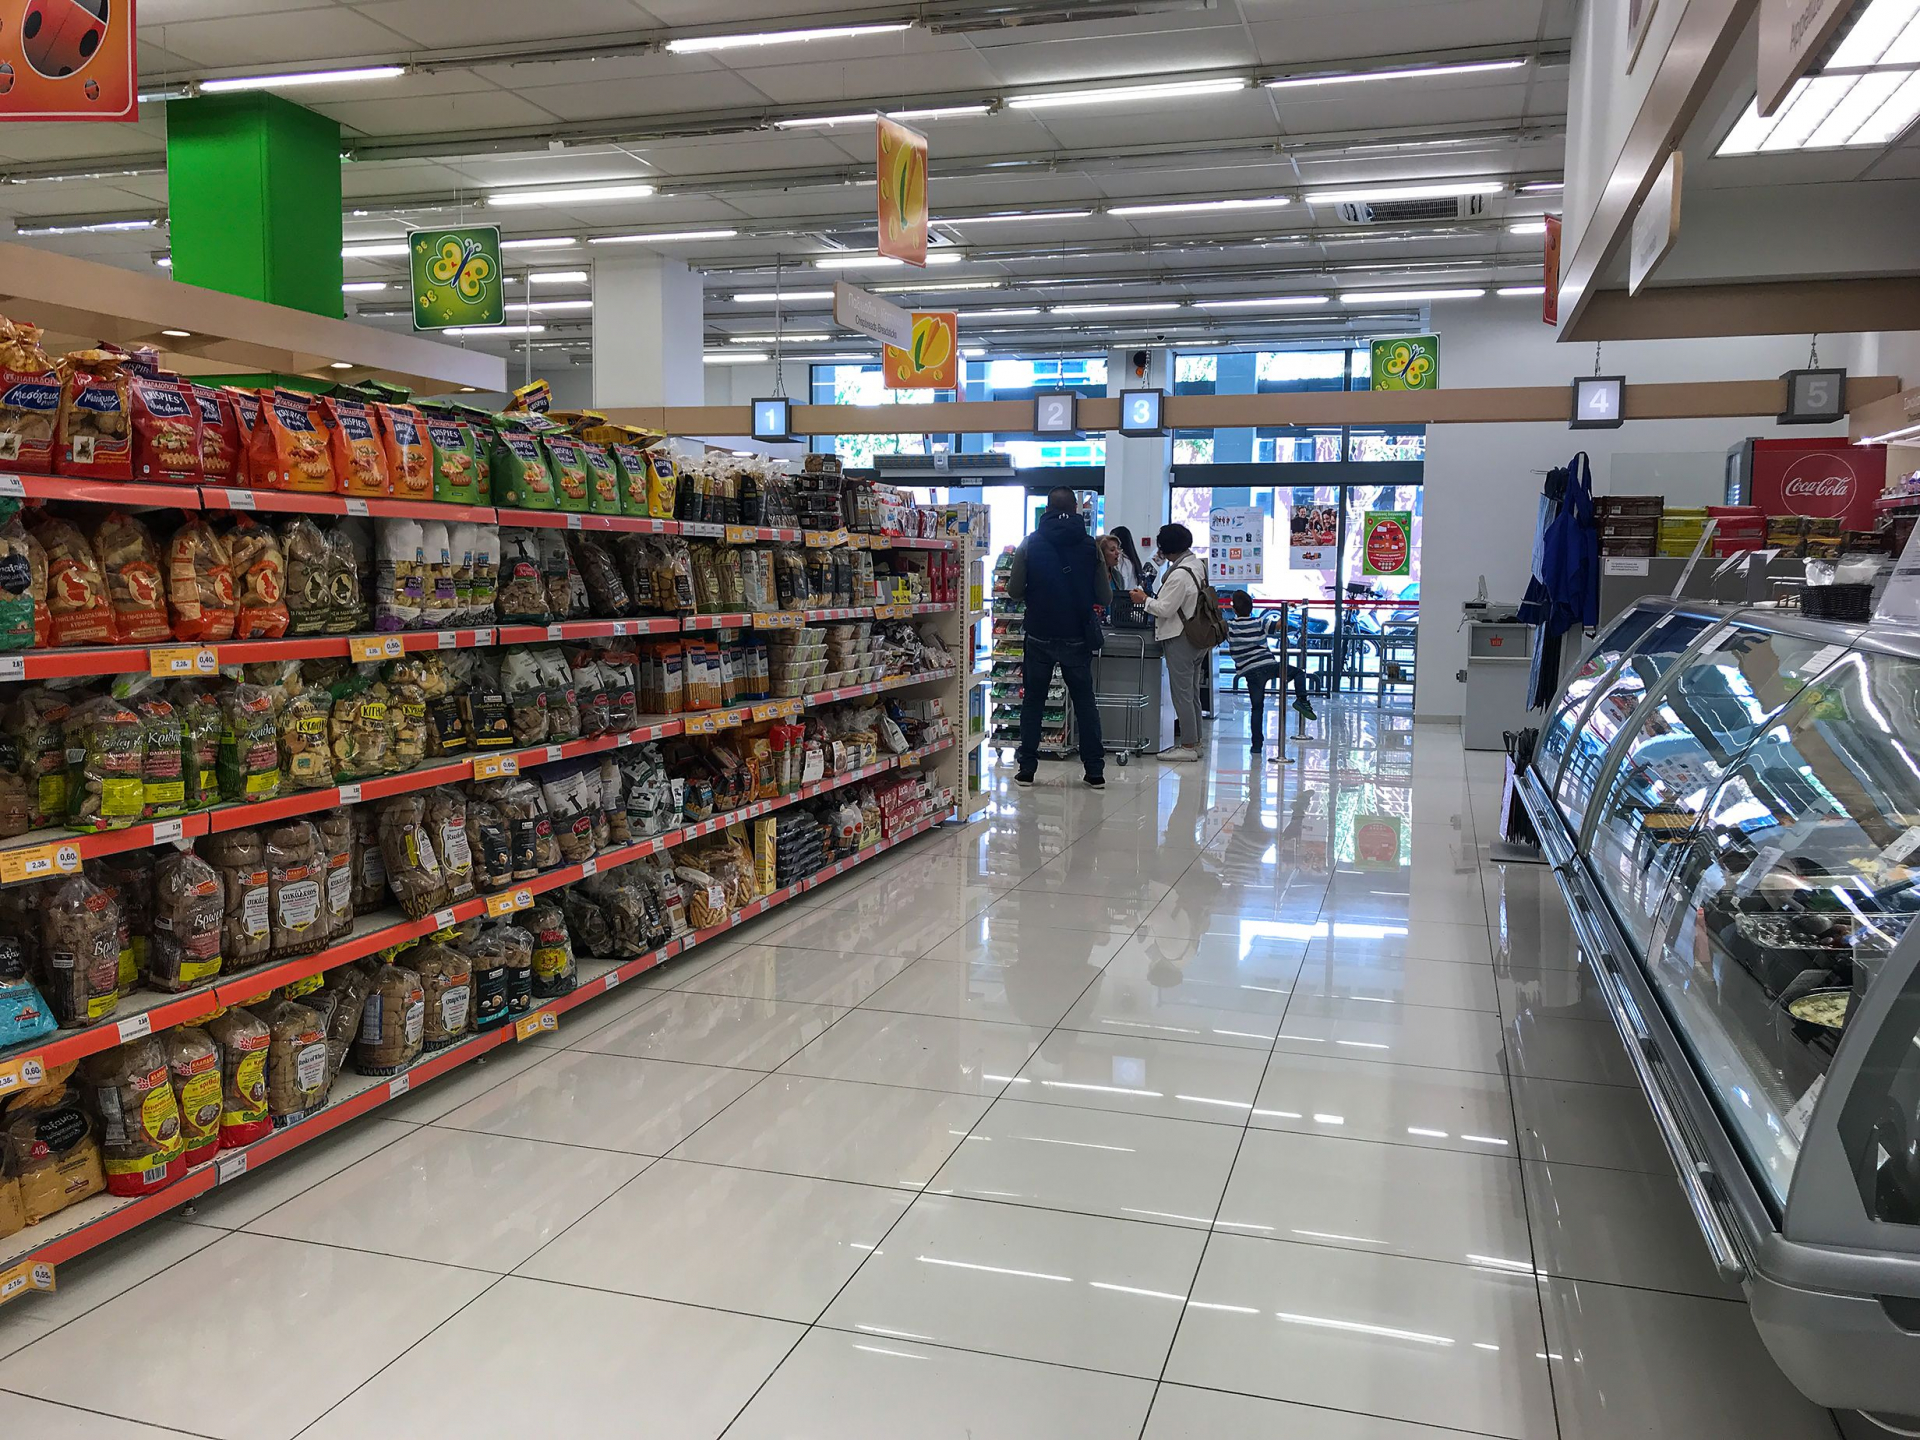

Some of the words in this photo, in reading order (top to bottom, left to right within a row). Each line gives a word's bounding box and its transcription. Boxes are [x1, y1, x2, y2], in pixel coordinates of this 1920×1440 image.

[142, 391, 180, 404] KRISPIES
[1589, 388, 1609, 412] 4
[1807, 381, 1828, 408] 5
[765, 408, 775, 430] 1
[1047, 402, 1064, 426] 2
[1132, 399, 1150, 424] 3
[432, 428, 459, 438] KRISPIES
[1785, 476, 1852, 497] Coca-Cola
[60, 853, 77, 862] 0,60€
[40, 1112, 79, 1132] παξαμάς
